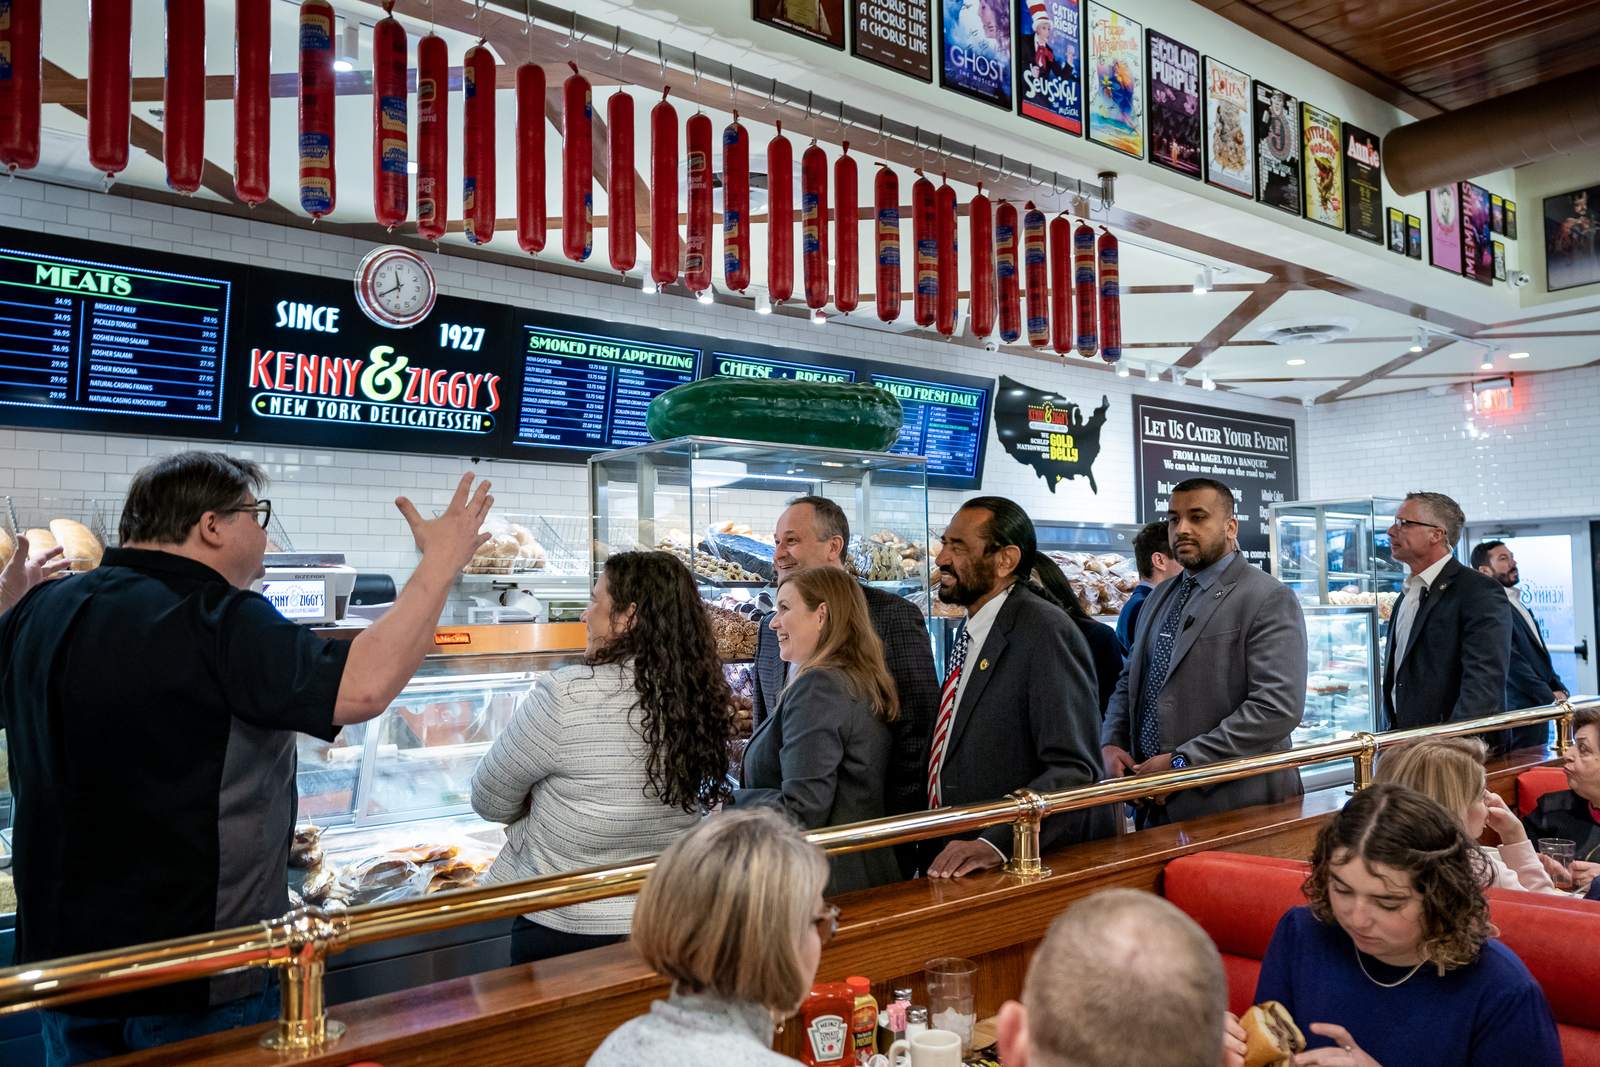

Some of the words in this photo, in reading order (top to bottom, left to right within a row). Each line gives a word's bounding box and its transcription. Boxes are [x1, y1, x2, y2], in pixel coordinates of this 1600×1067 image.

[860, 2, 866, 16] A
[869, 6, 906, 30] CHORUS
[909, 21, 927, 39] LINE
[909, 5, 927, 24] LINE
[1052, 2, 1078, 24] CATHY
[860, 18, 867, 31] A
[869, 22, 906, 46] CHORUS
[909, 36, 927, 55] LINE
[1054, 16, 1078, 37] RIGBY
[951, 45, 1004, 82] GHOST
[1159, 38, 1198, 77] COLOR
[1152, 58, 1198, 98] PURPLE
[1347, 134, 1379, 168] Annie
[1462, 182, 1476, 274] MEMPHIS
[36, 264, 132, 296] MEATS
[93, 318, 115, 327] PICKLED
[116, 321, 137, 329] TONGUE
[276, 300, 340, 333] SINCE
[439, 323, 485, 351] 1927
[93, 334, 114, 342] KOSHER
[92, 349, 113, 357] KOSHER
[530, 336, 586, 355] SMOKED
[589, 344, 620, 360] FISH
[622, 348, 692, 369] APPETIZING
[91, 364, 112, 372] KOSHER
[112, 366, 138, 375] BOLOGNA
[249, 348, 363, 397] KENNY
[360, 345, 409, 401] &
[403, 366, 501, 412] ZIGGY'S
[720, 362, 772, 379] CHEESE
[89, 395, 112, 403] NATURAL
[132, 398, 167, 407] KNOCKWURST
[914, 387, 949, 403] FRESH
[951, 391, 979, 407] DAILY
[270, 396, 307, 416] NEW
[317, 402, 361, 420] YORK
[370, 406, 482, 431] DELICATESSEN
[1017, 443, 1049, 452] NATIONWIDE
[1050, 433, 1073, 448] GOLD
[1186, 422, 1221, 444] CATER
[1223, 427, 1252, 448] YOUR
[1254, 431, 1288, 452] EVENT!
[1173, 450, 1194, 461] FROM
[1194, 453, 1200, 461] A
[1200, 453, 1222, 464] BAGEL
[1223, 456, 1230, 464] TO
[1232, 458, 1238, 466] A
[1163, 459, 1174, 470] We
[1175, 462, 1186, 470] can
[1187, 463, 1200, 472] take
[1212, 465, 1227, 475] show
[1236, 468, 1245, 476] the
[1246, 469, 1258, 478] road
[1265, 471, 1276, 480] you!
[1250, 551, 1266, 559] come
